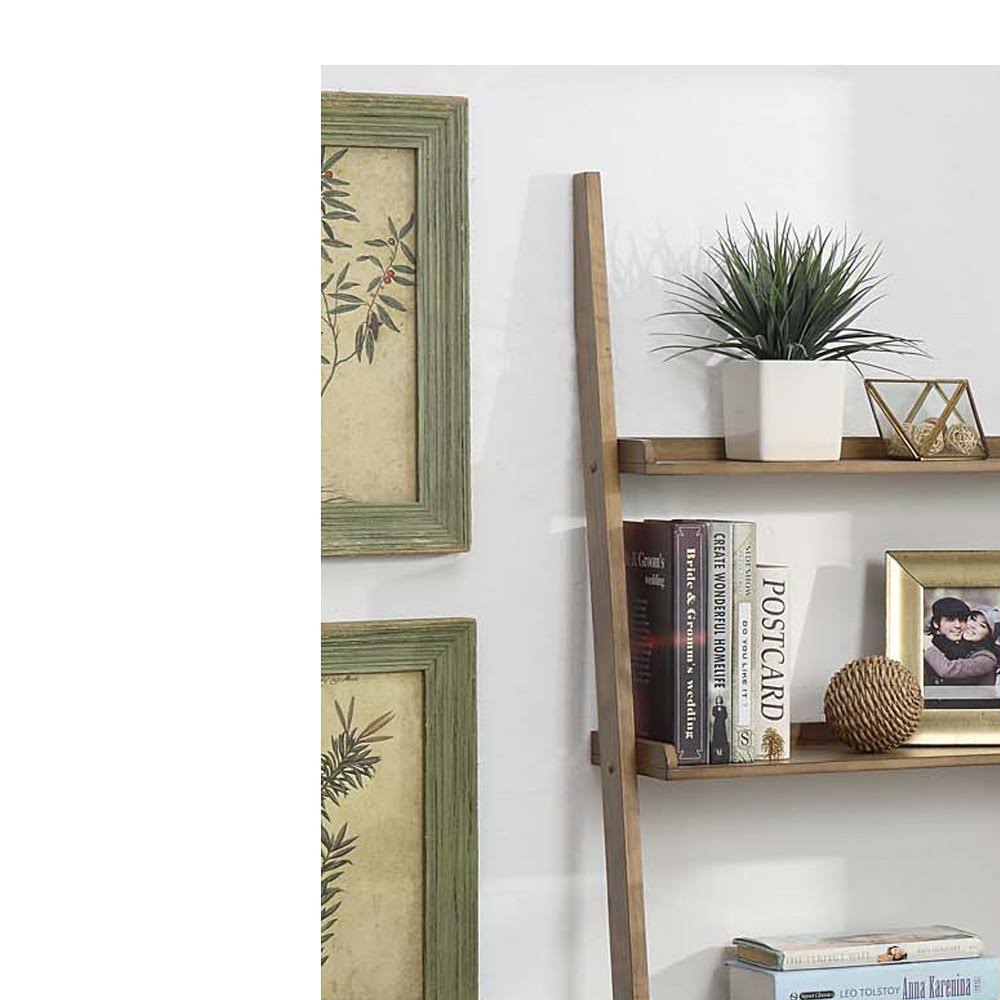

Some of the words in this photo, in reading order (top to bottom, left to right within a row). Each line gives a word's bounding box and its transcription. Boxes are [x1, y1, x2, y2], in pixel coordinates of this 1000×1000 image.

[686, 548, 696, 590] Bride
[713, 533, 726, 570] CREATE
[686, 592, 696, 605] &
[713, 572, 726, 635] WONDERFUL
[742, 620, 748, 635] DO
[713, 639, 726, 689] HOMELIFE
[760, 578, 786, 721] POSTCARD
[685, 680, 696, 740] wedding
[840, 988, 858, 999] LEO
[860, 986, 900, 998] TOLSTOY
[902, 976, 926, 1000] Anna
[929, 973, 971, 999] Karenina
